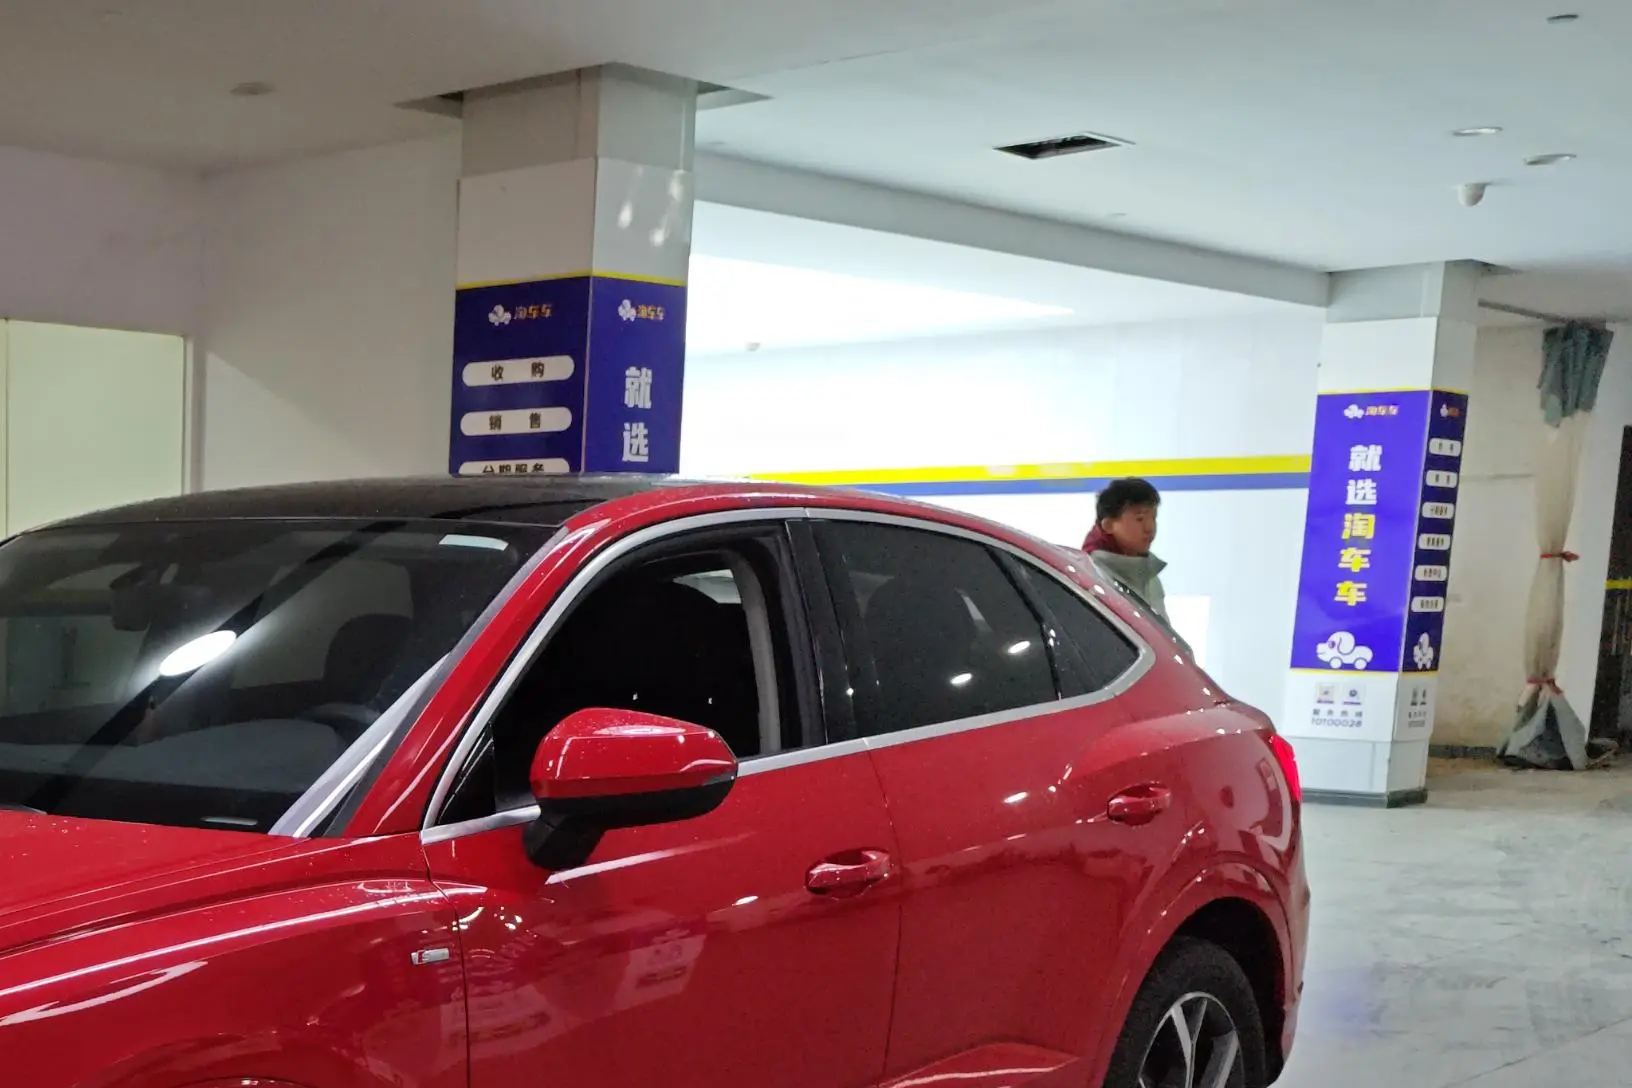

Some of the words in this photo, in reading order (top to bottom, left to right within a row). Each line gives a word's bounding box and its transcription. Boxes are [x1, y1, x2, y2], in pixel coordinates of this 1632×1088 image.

[491, 361, 545, 381] 收购
[488, 412, 542, 431] 销售
[623, 366, 653, 462] 就选
[1334, 445, 1383, 606] 就选淘车车
